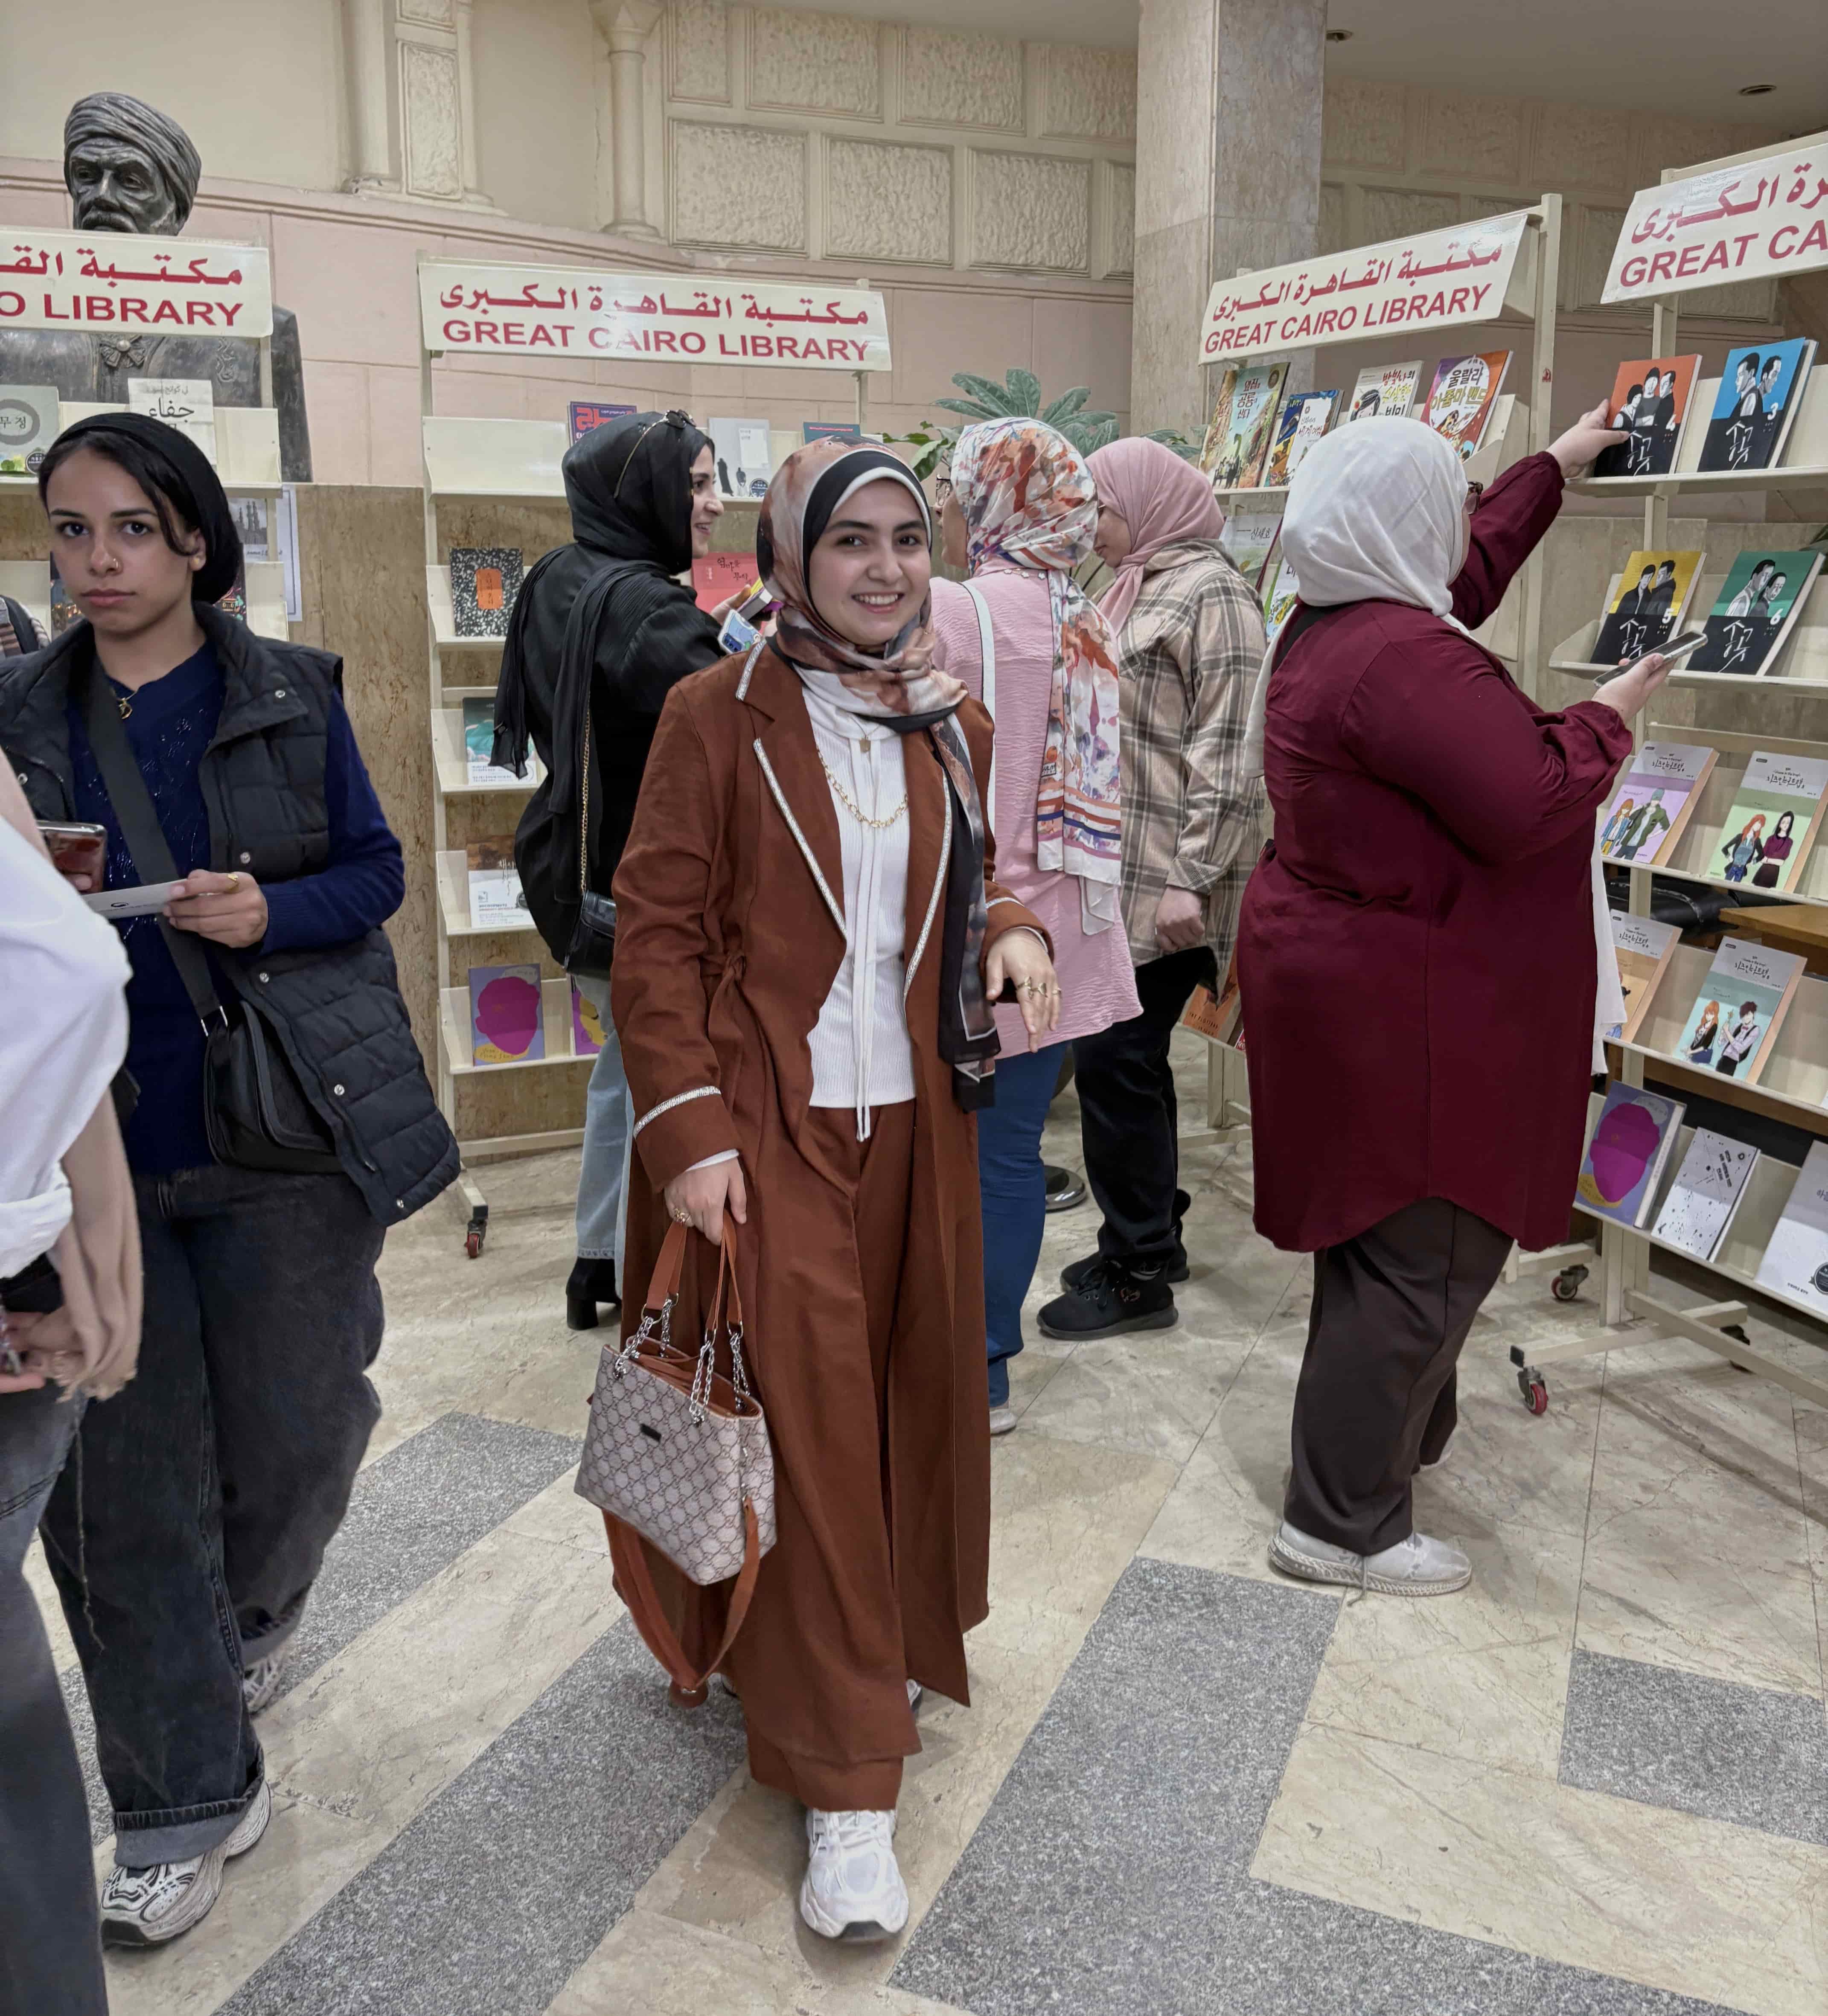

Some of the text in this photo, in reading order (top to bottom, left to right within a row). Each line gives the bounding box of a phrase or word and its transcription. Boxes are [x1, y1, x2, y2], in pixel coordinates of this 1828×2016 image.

[1631, 174, 1781, 243] الكبرى
[77, 248, 242, 288] مكتبة
[1620, 233, 1760, 287] GREAT
[1213, 241, 1503, 321] مكتبة القاهرة الكبرى
[44, 294, 244, 326] LIBRARY
[440, 283, 868, 328] مكتبة القاهرة الكبرى
[1205, 283, 1493, 354] GREAT CAIRO LIBRARY
[443, 320, 869, 361] GREAT CAIRO LIBRARY
[1448, 367, 1484, 389] 울랄라
[149, 396, 195, 423] جفاء
[1431, 385, 1467, 410] 아줌마
[1767, 402, 1779, 420] 3
[1665, 414, 1677, 431] 4
[1662, 608, 1674, 624] 5
[1770, 608, 1783, 625] 6
